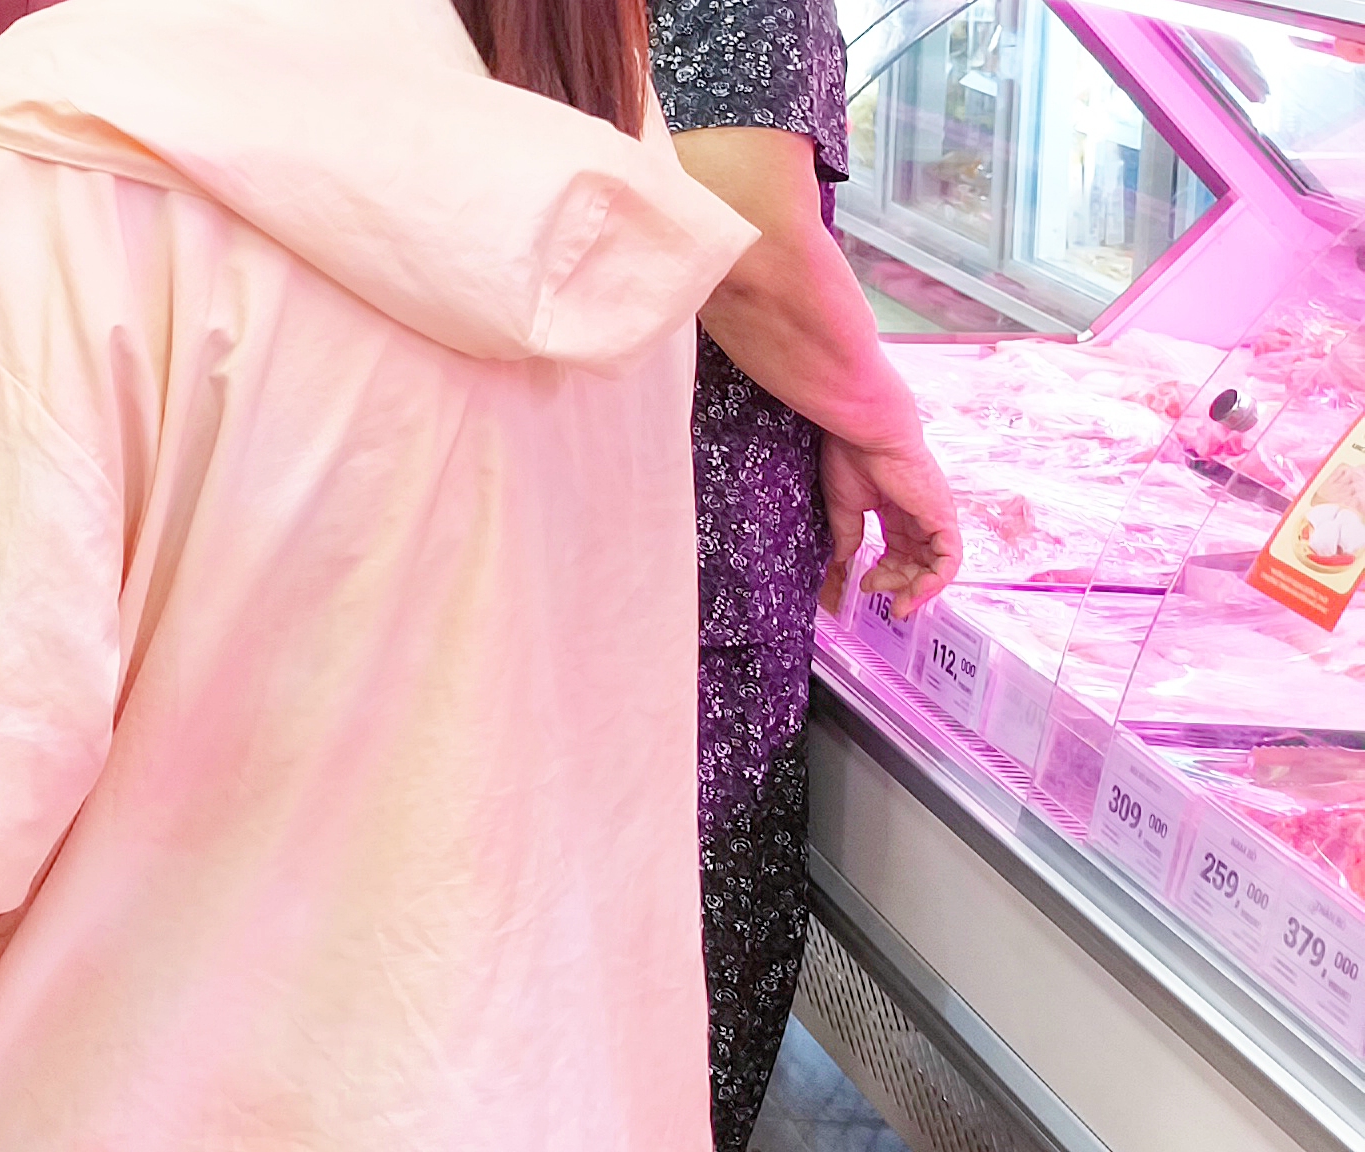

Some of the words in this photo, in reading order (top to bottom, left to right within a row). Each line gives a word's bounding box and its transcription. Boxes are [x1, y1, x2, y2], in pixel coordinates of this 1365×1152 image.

[930, 638, 976, 683] 112,000
[1107, 783, 1169, 840] 309,000
[1199, 851, 1270, 911] 259,000
[1282, 915, 1360, 981] 379,000
